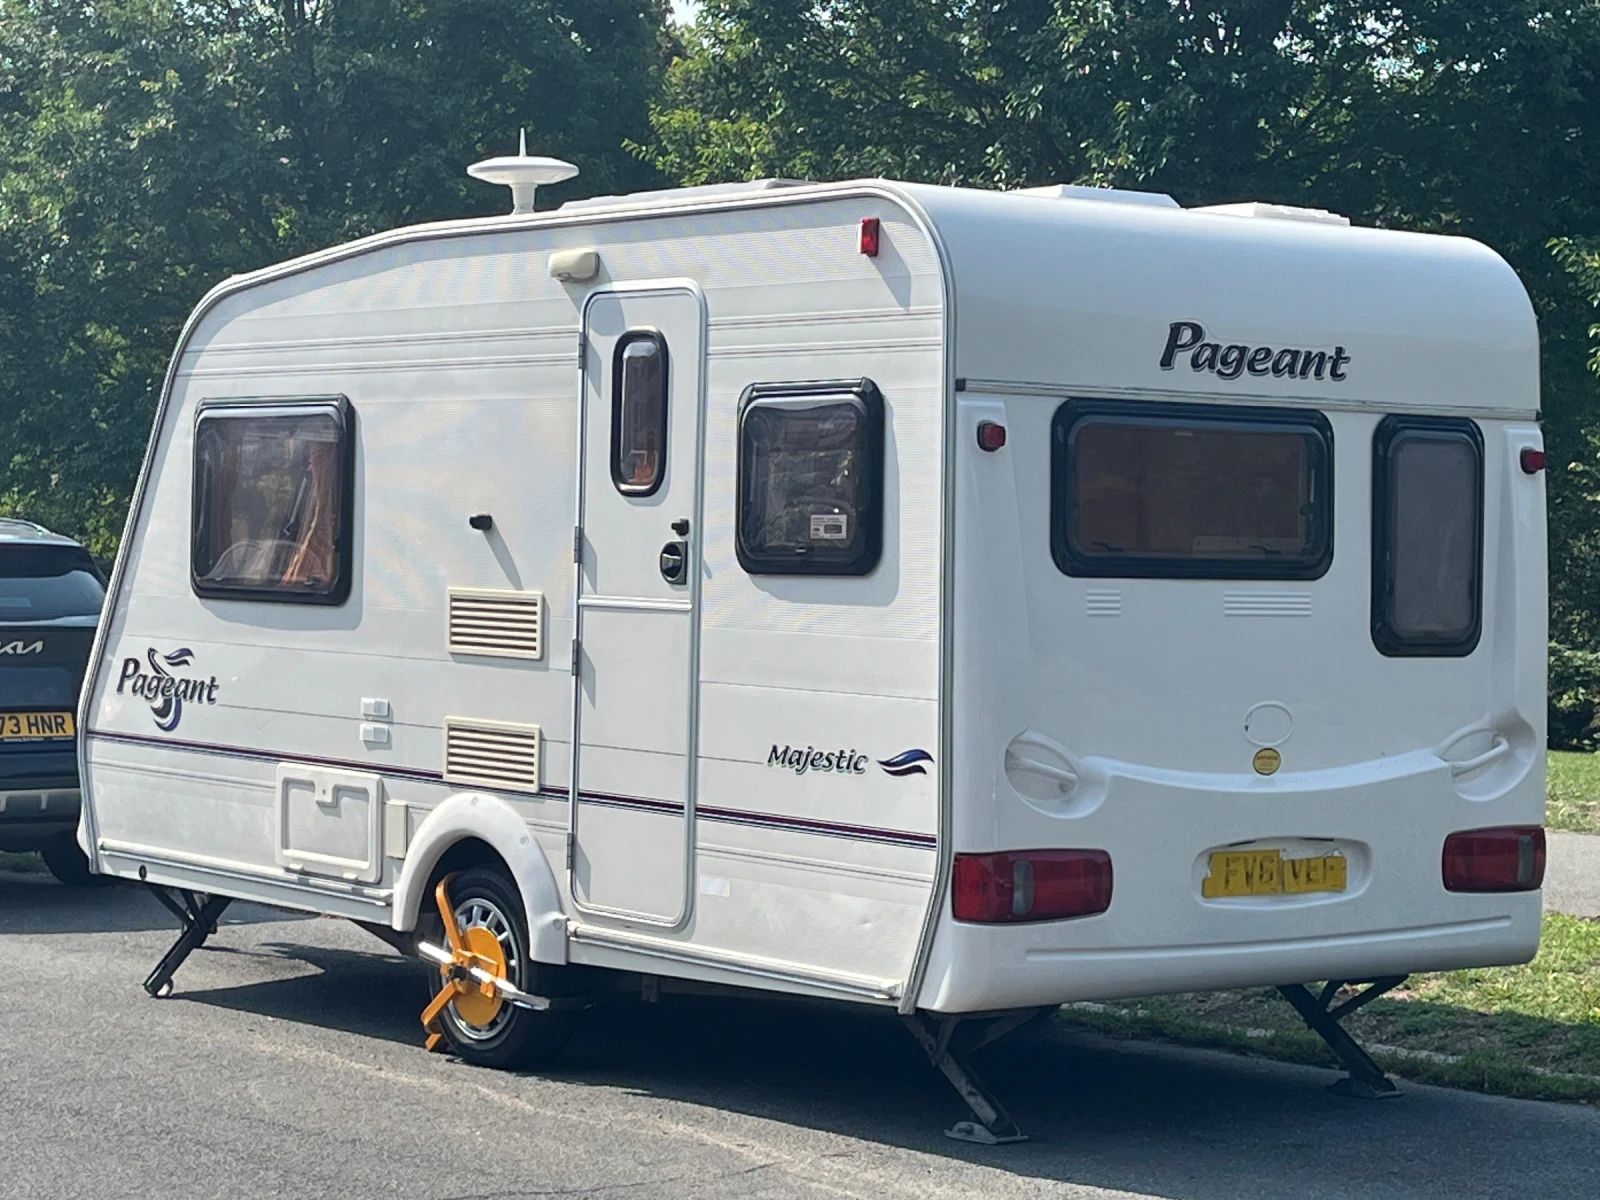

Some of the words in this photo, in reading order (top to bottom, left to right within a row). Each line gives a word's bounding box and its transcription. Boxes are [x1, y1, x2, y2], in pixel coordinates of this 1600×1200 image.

[1159, 321, 1351, 381] Pageant
[116, 657, 219, 705] Pageant
[26, 715, 67, 735] HNR
[767, 744, 869, 775] Majestic
